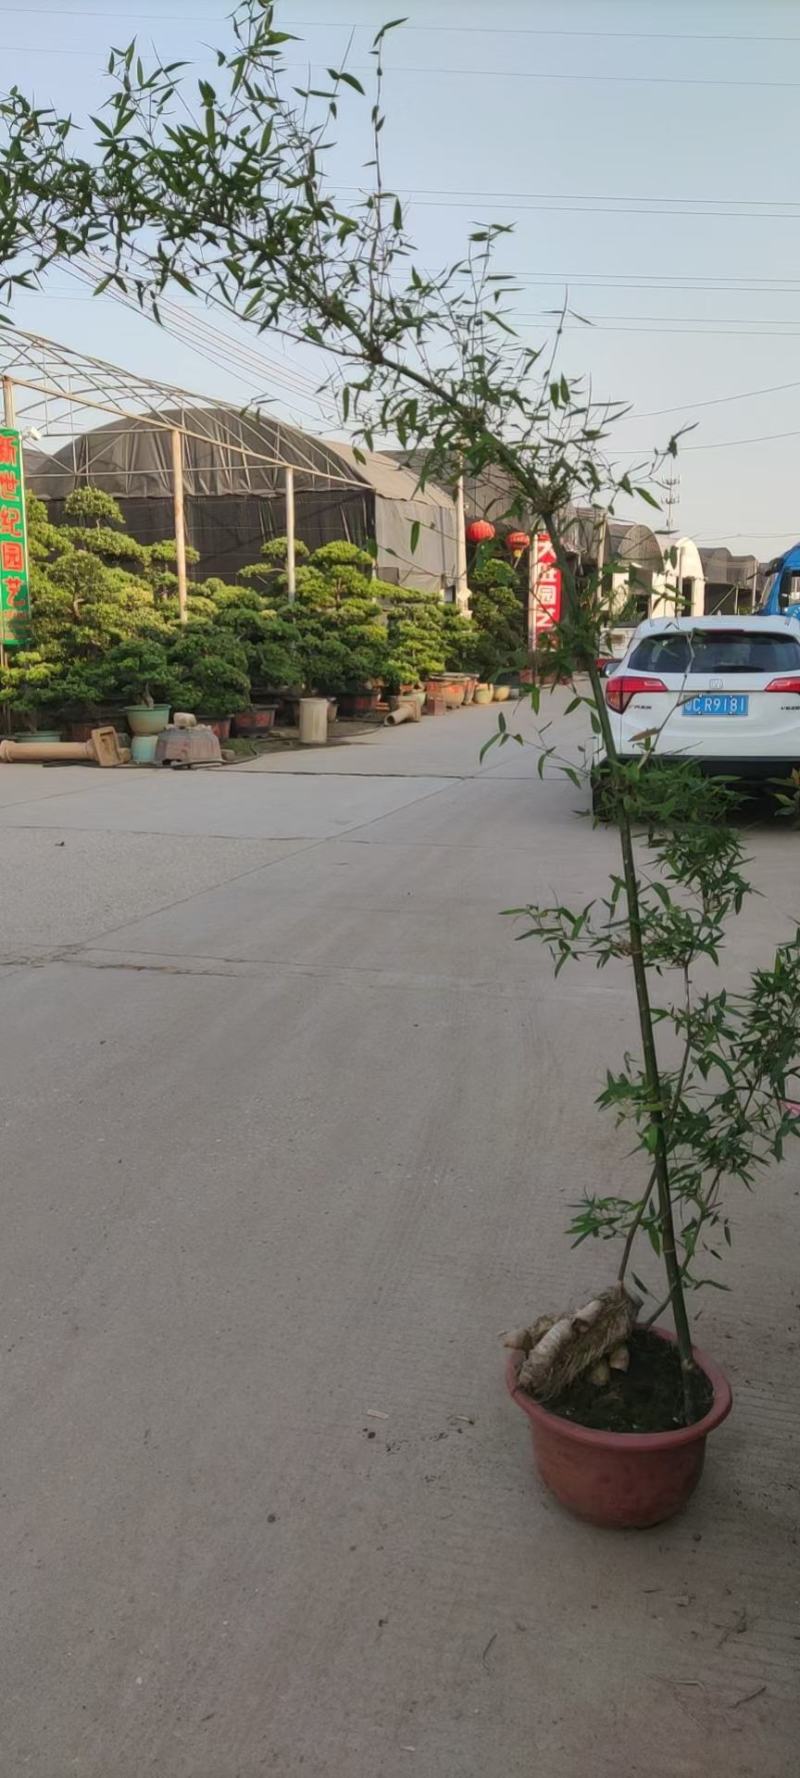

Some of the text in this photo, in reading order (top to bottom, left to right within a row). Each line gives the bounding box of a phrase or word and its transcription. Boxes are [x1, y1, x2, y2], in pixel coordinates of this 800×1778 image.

[0, 436, 25, 607] 新世纪园艺
